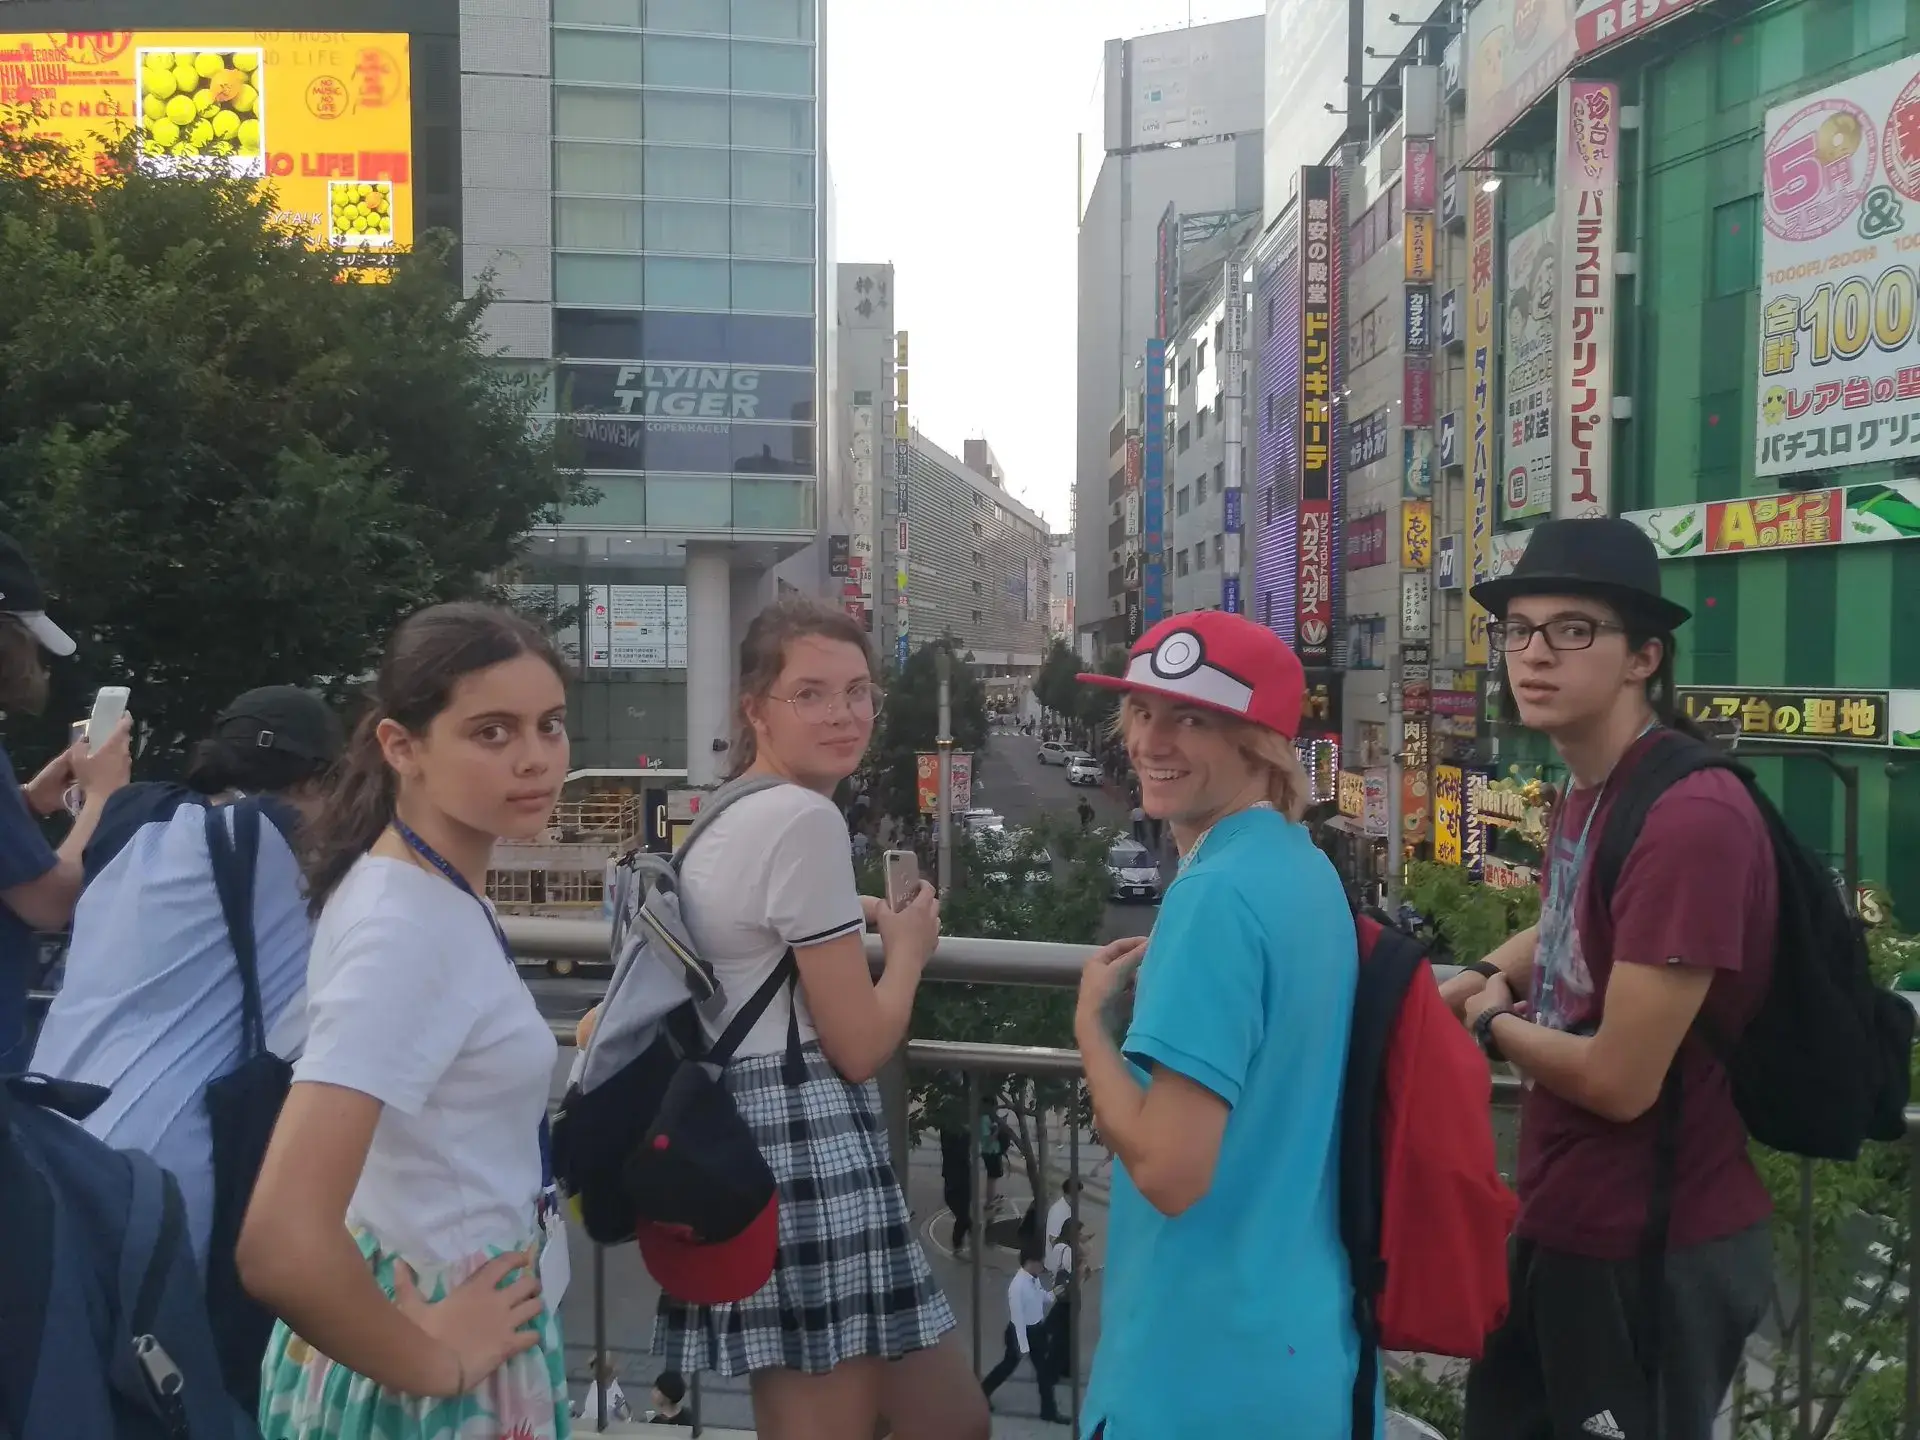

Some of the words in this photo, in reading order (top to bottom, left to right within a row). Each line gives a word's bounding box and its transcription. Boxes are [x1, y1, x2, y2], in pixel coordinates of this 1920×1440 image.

[301, 152, 355, 177] LIFE
[616, 366, 760, 391] FLYING
[613, 389, 758, 417] TIGER
[646, 422, 730, 434] COPENHAGEN
[1302, 512, 1319, 614] ベガスベガス
